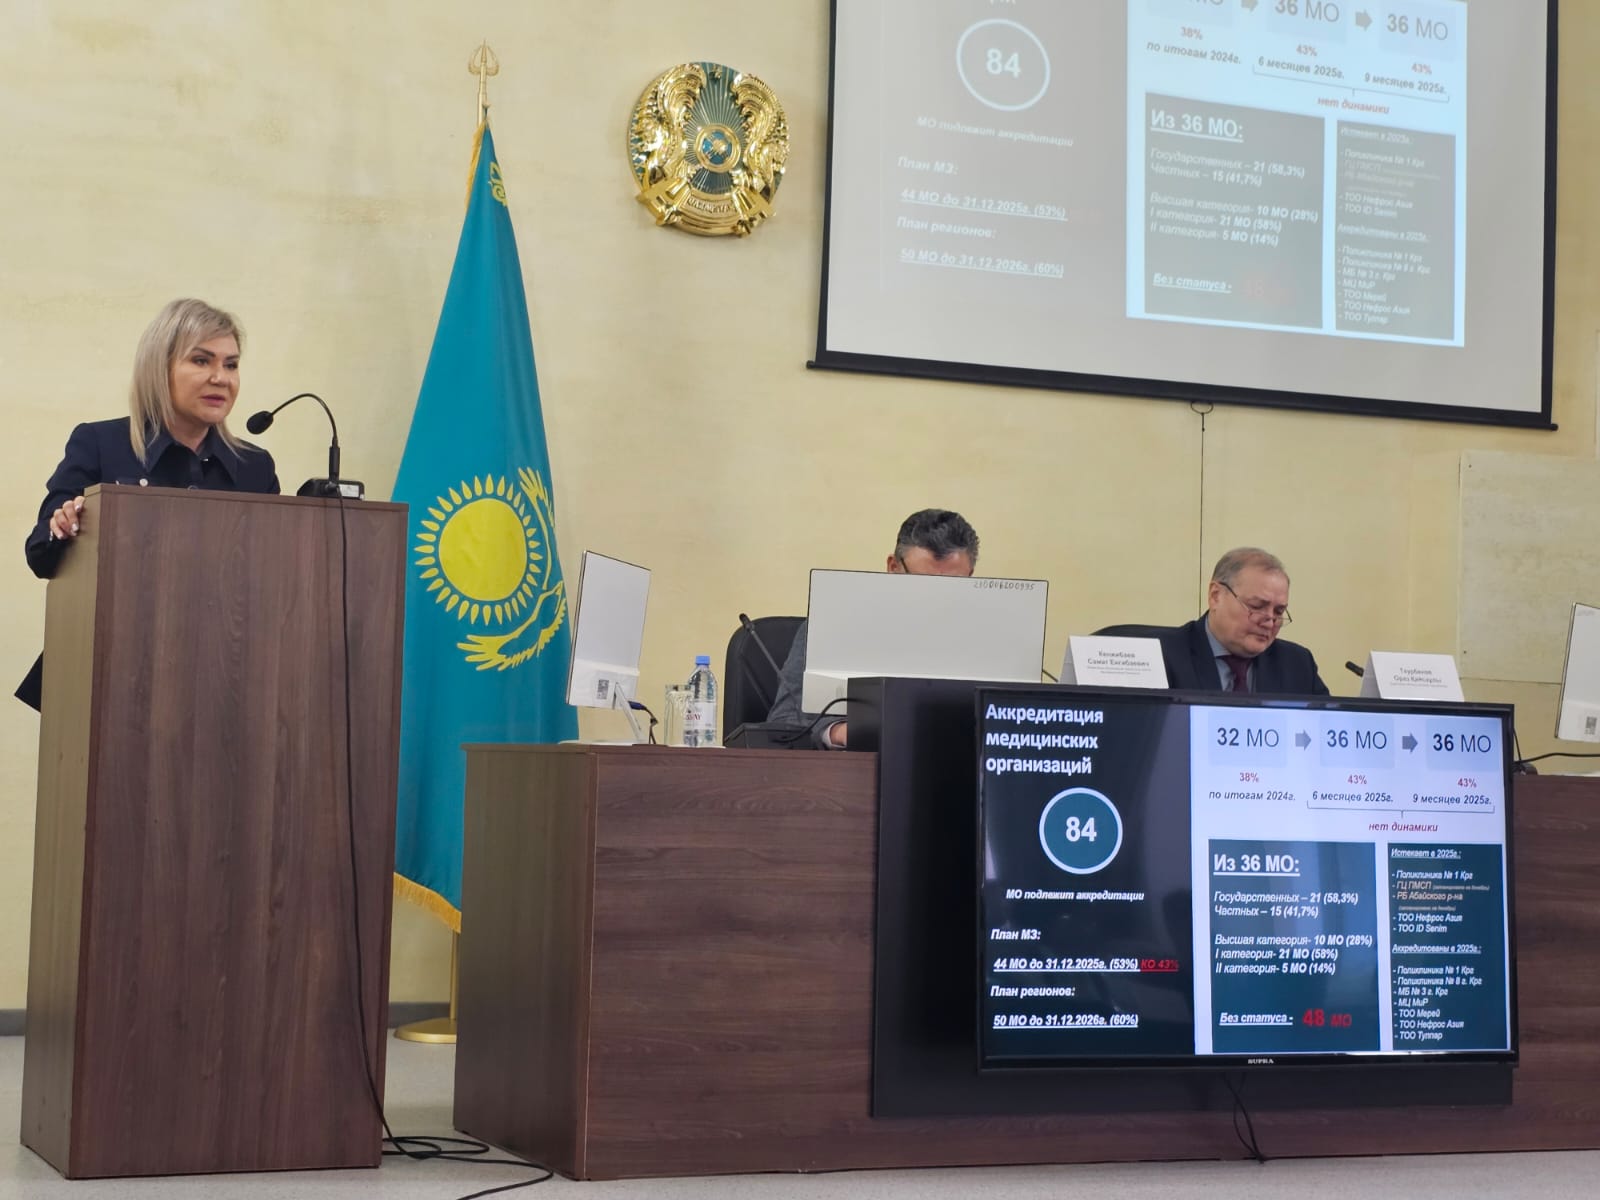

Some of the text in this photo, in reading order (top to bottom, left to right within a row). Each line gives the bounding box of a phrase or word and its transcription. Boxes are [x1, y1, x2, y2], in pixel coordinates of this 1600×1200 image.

[1306, 2, 1340, 23] МО
[1180, 26, 1203, 40] 38%
[1387, 14, 1448, 41] 36 МО
[1147, 41, 1161, 52] по
[1296, 44, 1318, 57] 43%
[986, 48, 1021, 78] 84
[1258, 56, 1265, 66] 6
[1411, 62, 1432, 76] 43%
[1364, 73, 1371, 83] 9
[1317, 96, 1390, 115] нет динамики
[1151, 109, 1244, 139] Из 36 МО:
[898, 156, 958, 175] План МЗ:
[1034, 204, 1066, 218] (53%)
[897, 216, 996, 239] План регионов:
[1153, 273, 1226, 291] Без статуса
[985, 704, 1104, 726] Аккредитация
[986, 732, 1098, 750] медицинских
[1217, 727, 1279, 748] 32 МО
[1326, 729, 1387, 750] 36 МО
[1432, 733, 1492, 753] 36 МО
[986, 756, 1092, 776] организаций
[1239, 772, 1259, 783] 38%
[1347, 774, 1367, 785] 43%
[1457, 778, 1477, 789] 43%
[1209, 791, 1296, 801] по итогам 2024г.
[1312, 791, 1394, 803] 6 месяцев 2025г.
[1412, 794, 1492, 805] 9 месяцев 2025г.
[1065, 816, 1097, 842] 84
[1369, 822, 1438, 833] нет динамики
[1391, 848, 1430, 857] Истекает
[1214, 854, 1299, 873] Из 36 МО:
[1006, 889, 1145, 902] МО подлежит аккредитации
[1214, 891, 1359, 905] Государственных 21 (58,3%)
[1408, 892, 1446, 901] Абайского
[1447, 893, 1463, 902] р-на
[1215, 906, 1319, 918] Частных 15 (41,7%)
[1398, 913, 1463, 923] ТОО Нефрос Азия
[991, 929, 1041, 941] План МЗ:
[1398, 924, 1414, 933] ТОО
[1425, 924, 1447, 933] Senim
[1215, 934, 1373, 947] Высшая категория- 10 МО (28%)
[1278, 949, 1290, 959] 21
[1292, 949, 1309, 959] МО
[1311, 949, 1338, 961] (58%)
[993, 958, 1007, 969] 44
[1009, 958, 1027, 969] МО
[1029, 958, 1043, 969] до
[1045, 958, 1107, 970] 31.12.2025г.
[1109, 958, 1138, 970] (53%)
[1282, 963, 1288, 973] 5
[1290, 963, 1307, 973] МО
[1309, 963, 1335, 975] (14%)
[991, 985, 1076, 999] План регионов:
[1398, 987, 1410, 996] МБ
[1421, 987, 1426, 996] 3
[993, 1014, 1138, 1027] 50 МО до 31.12.2026г. (60%)
[1220, 1012, 1239, 1023] Без
[1241, 1013, 1288, 1024] статуса
[1302, 1008, 1325, 1026] 48
[1399, 1009, 1441, 1019] ТОО Мерей
[1400, 1020, 1464, 1030] ТОО Нефрос Азия
[1400, 1031, 1416, 1040] ТОО
